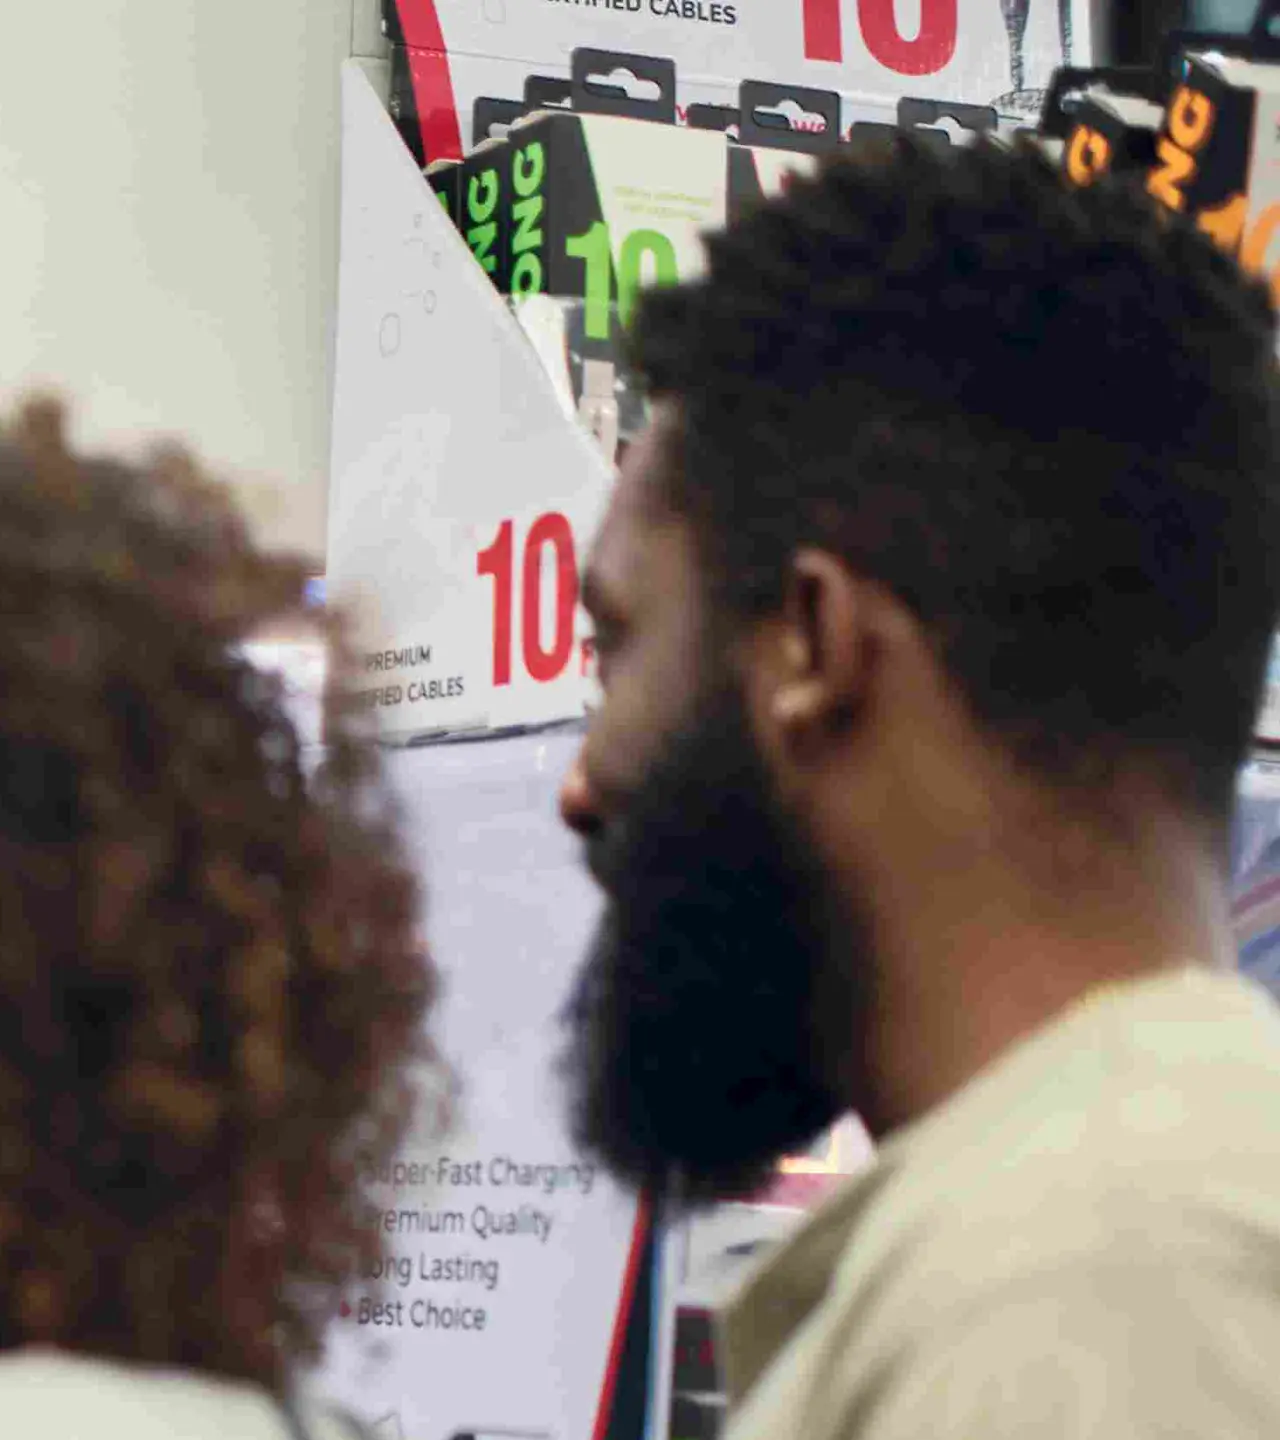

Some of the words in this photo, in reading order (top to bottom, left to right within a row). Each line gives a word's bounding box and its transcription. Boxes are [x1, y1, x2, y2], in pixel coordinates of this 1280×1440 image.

[648, 0, 738, 25] CABLES
[466, 168, 499, 273] NG
[511, 141, 545, 303] ONG
[475, 511, 579, 688] 10
[363, 644, 432, 672] PREMIUM
[407, 675, 465, 703] CABLES
[364, 1156, 483, 1192] uper-Fast
[489, 1156, 597, 1195] Chargng
[366, 1202, 465, 1234] remium
[471, 1204, 553, 1244] Quaty
[364, 1255, 412, 1288] ong
[419, 1251, 499, 1290] Lasting
[357, 1297, 404, 1327] Best
[409, 1299, 487, 1331] Choice
